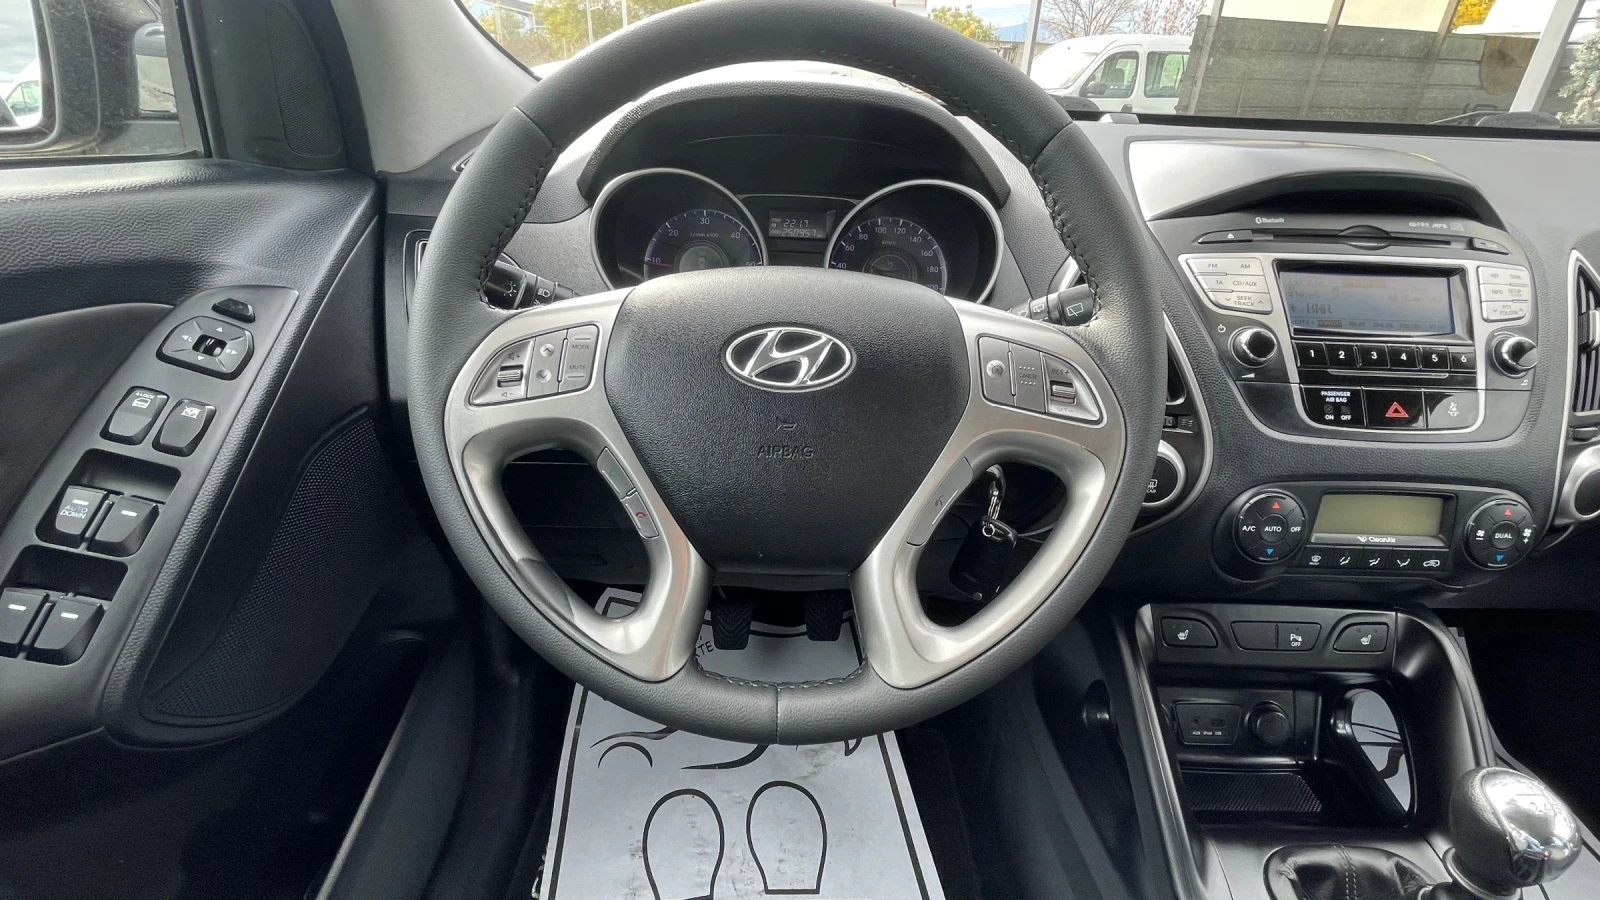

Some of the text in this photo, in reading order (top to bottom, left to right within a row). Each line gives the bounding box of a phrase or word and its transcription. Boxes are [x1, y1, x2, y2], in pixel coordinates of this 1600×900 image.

[1306, 303, 1332, 314] BNR
[1310, 350, 1315, 358] 1
[1400, 352, 1407, 360] 4
[757, 444, 814, 459] AIRBAG
[64, 504, 88, 513] AUTO
[60, 510, 87, 519] DOWN
